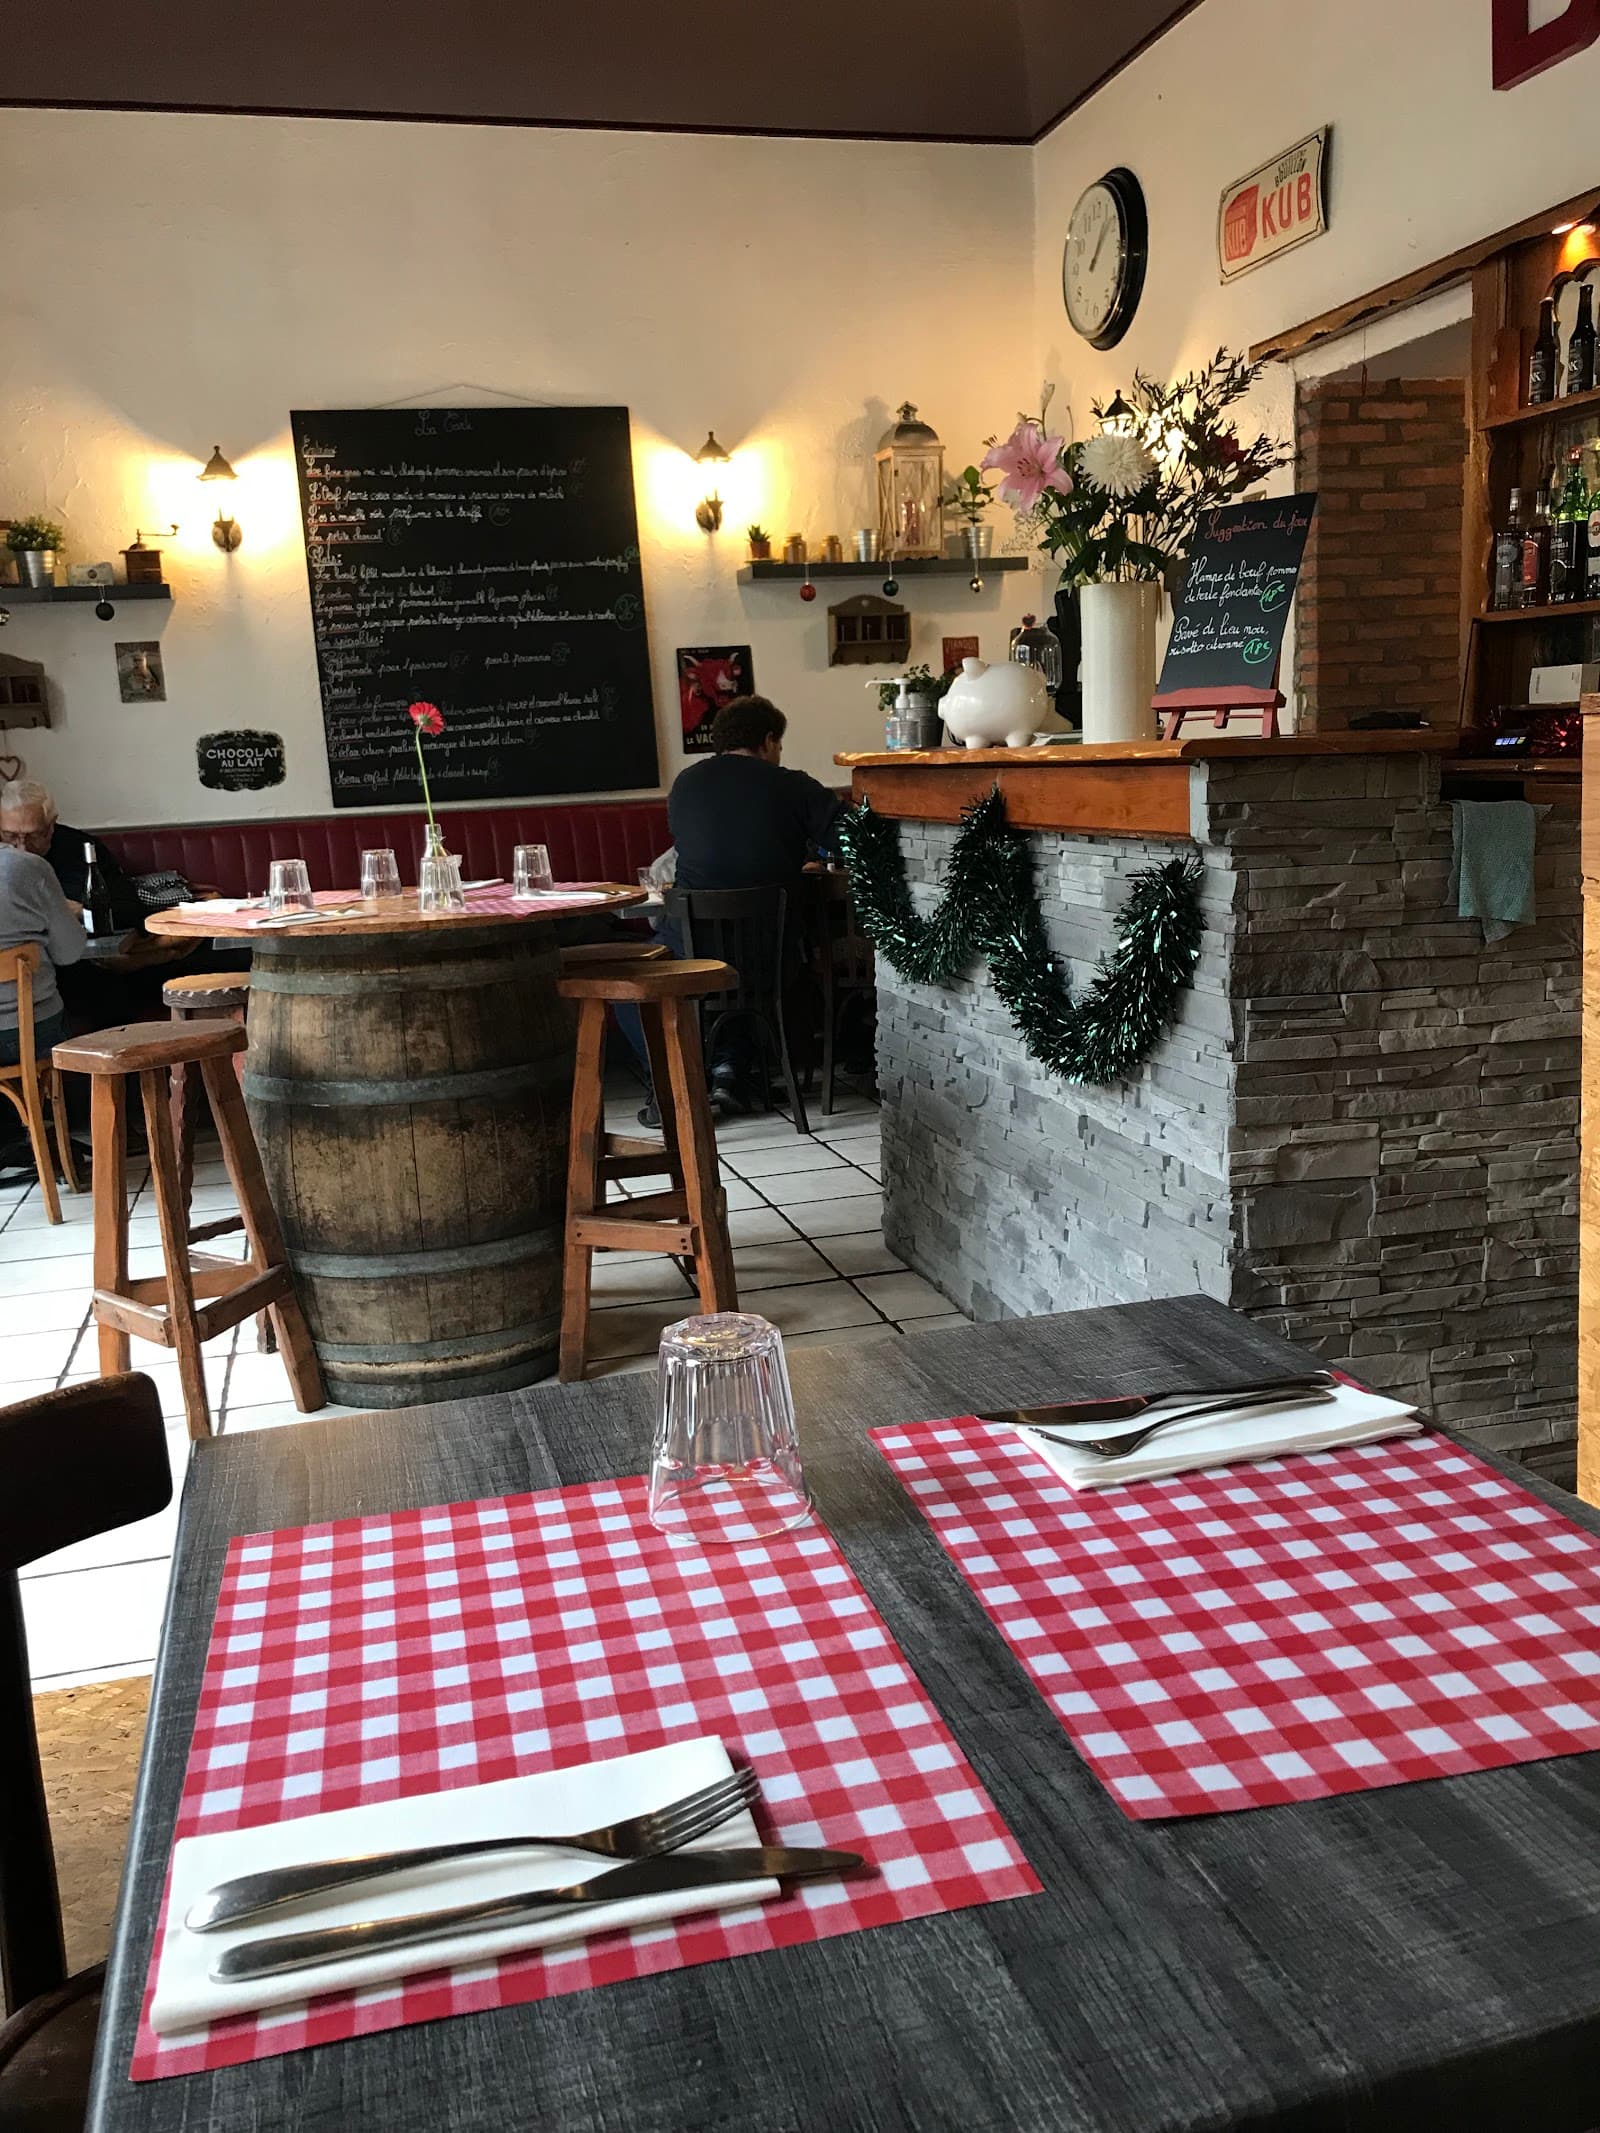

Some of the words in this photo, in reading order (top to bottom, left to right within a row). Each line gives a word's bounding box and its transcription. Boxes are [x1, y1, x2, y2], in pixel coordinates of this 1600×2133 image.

[1262, 171, 1311, 239] KUB
[1226, 219, 1249, 259] KUB
[1204, 509, 1268, 542] Suggestion
[1272, 509, 1286, 529] du
[1186, 555, 1224, 594] Hampe
[1224, 563, 1235, 582] de
[1184, 589, 1196, 605] de
[1173, 615, 1200, 642] Pavé
[1202, 616, 1216, 635] de
[1219, 611, 1240, 635] lieu
[1168, 640, 1205, 656] risotto
[1205, 635, 1247, 651] citronné
[206, 747, 279, 759] CHOCOLAT
[221, 759, 235, 768] AU
[237, 757, 265, 767] LAIT
